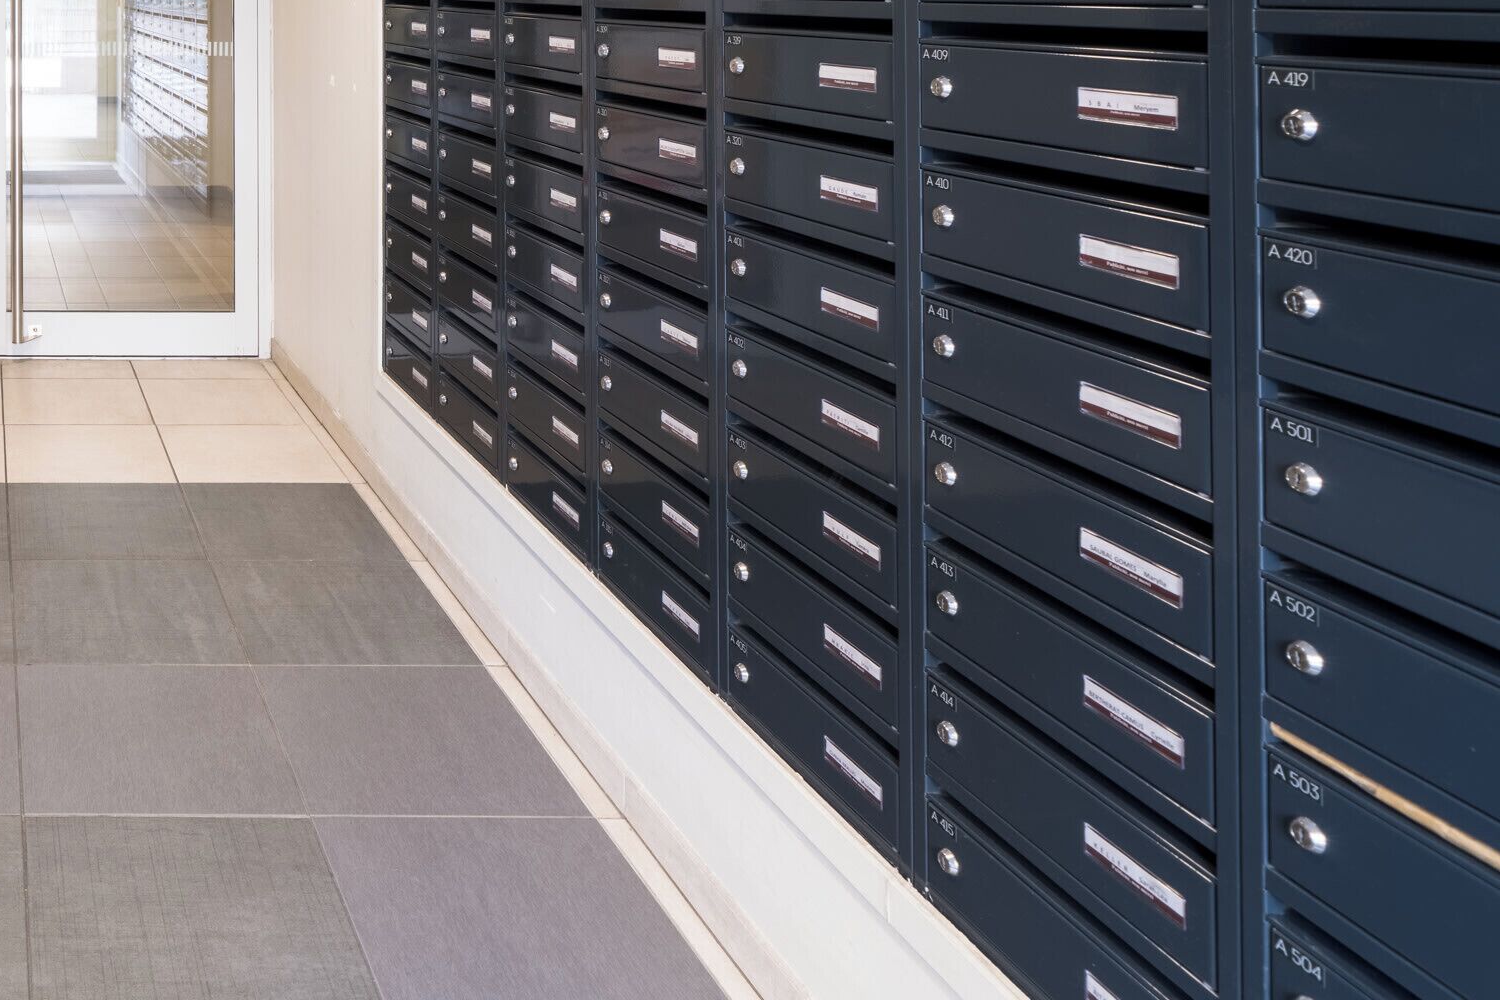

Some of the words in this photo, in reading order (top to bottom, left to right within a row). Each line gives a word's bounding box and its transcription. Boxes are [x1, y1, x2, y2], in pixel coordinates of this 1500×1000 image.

[922, 48, 930, 59] A
[931, 49, 948, 61] 409
[1267, 70, 1281, 85] A
[1283, 72, 1309, 87] 419
[926, 175, 934, 186] A
[934, 178, 949, 190] 410
[1267, 244, 1281, 259] A
[1284, 249, 1313, 265] 420
[928, 304, 936, 315] A
[936, 307, 950, 320] 411
[930, 429, 938, 441] A
[938, 434, 953, 449] 412
[1269, 416, 1283, 433] A
[1286, 422, 1314, 444] 501
[931, 556, 939, 569] A
[939, 562, 954, 578] 413
[1114, 555, 1137, 572] GOMES
[1268, 589, 1283, 608] A
[1285, 596, 1316, 623] 502
[931, 684, 939, 697] A
[939, 691, 954, 708] 414
[1272, 763, 1286, 781] A
[1289, 773, 1320, 801] 503
[931, 810, 939, 824] A
[939, 818, 954, 837] 415
[1275, 938, 1288, 956] A
[1290, 946, 1322, 982] 504
